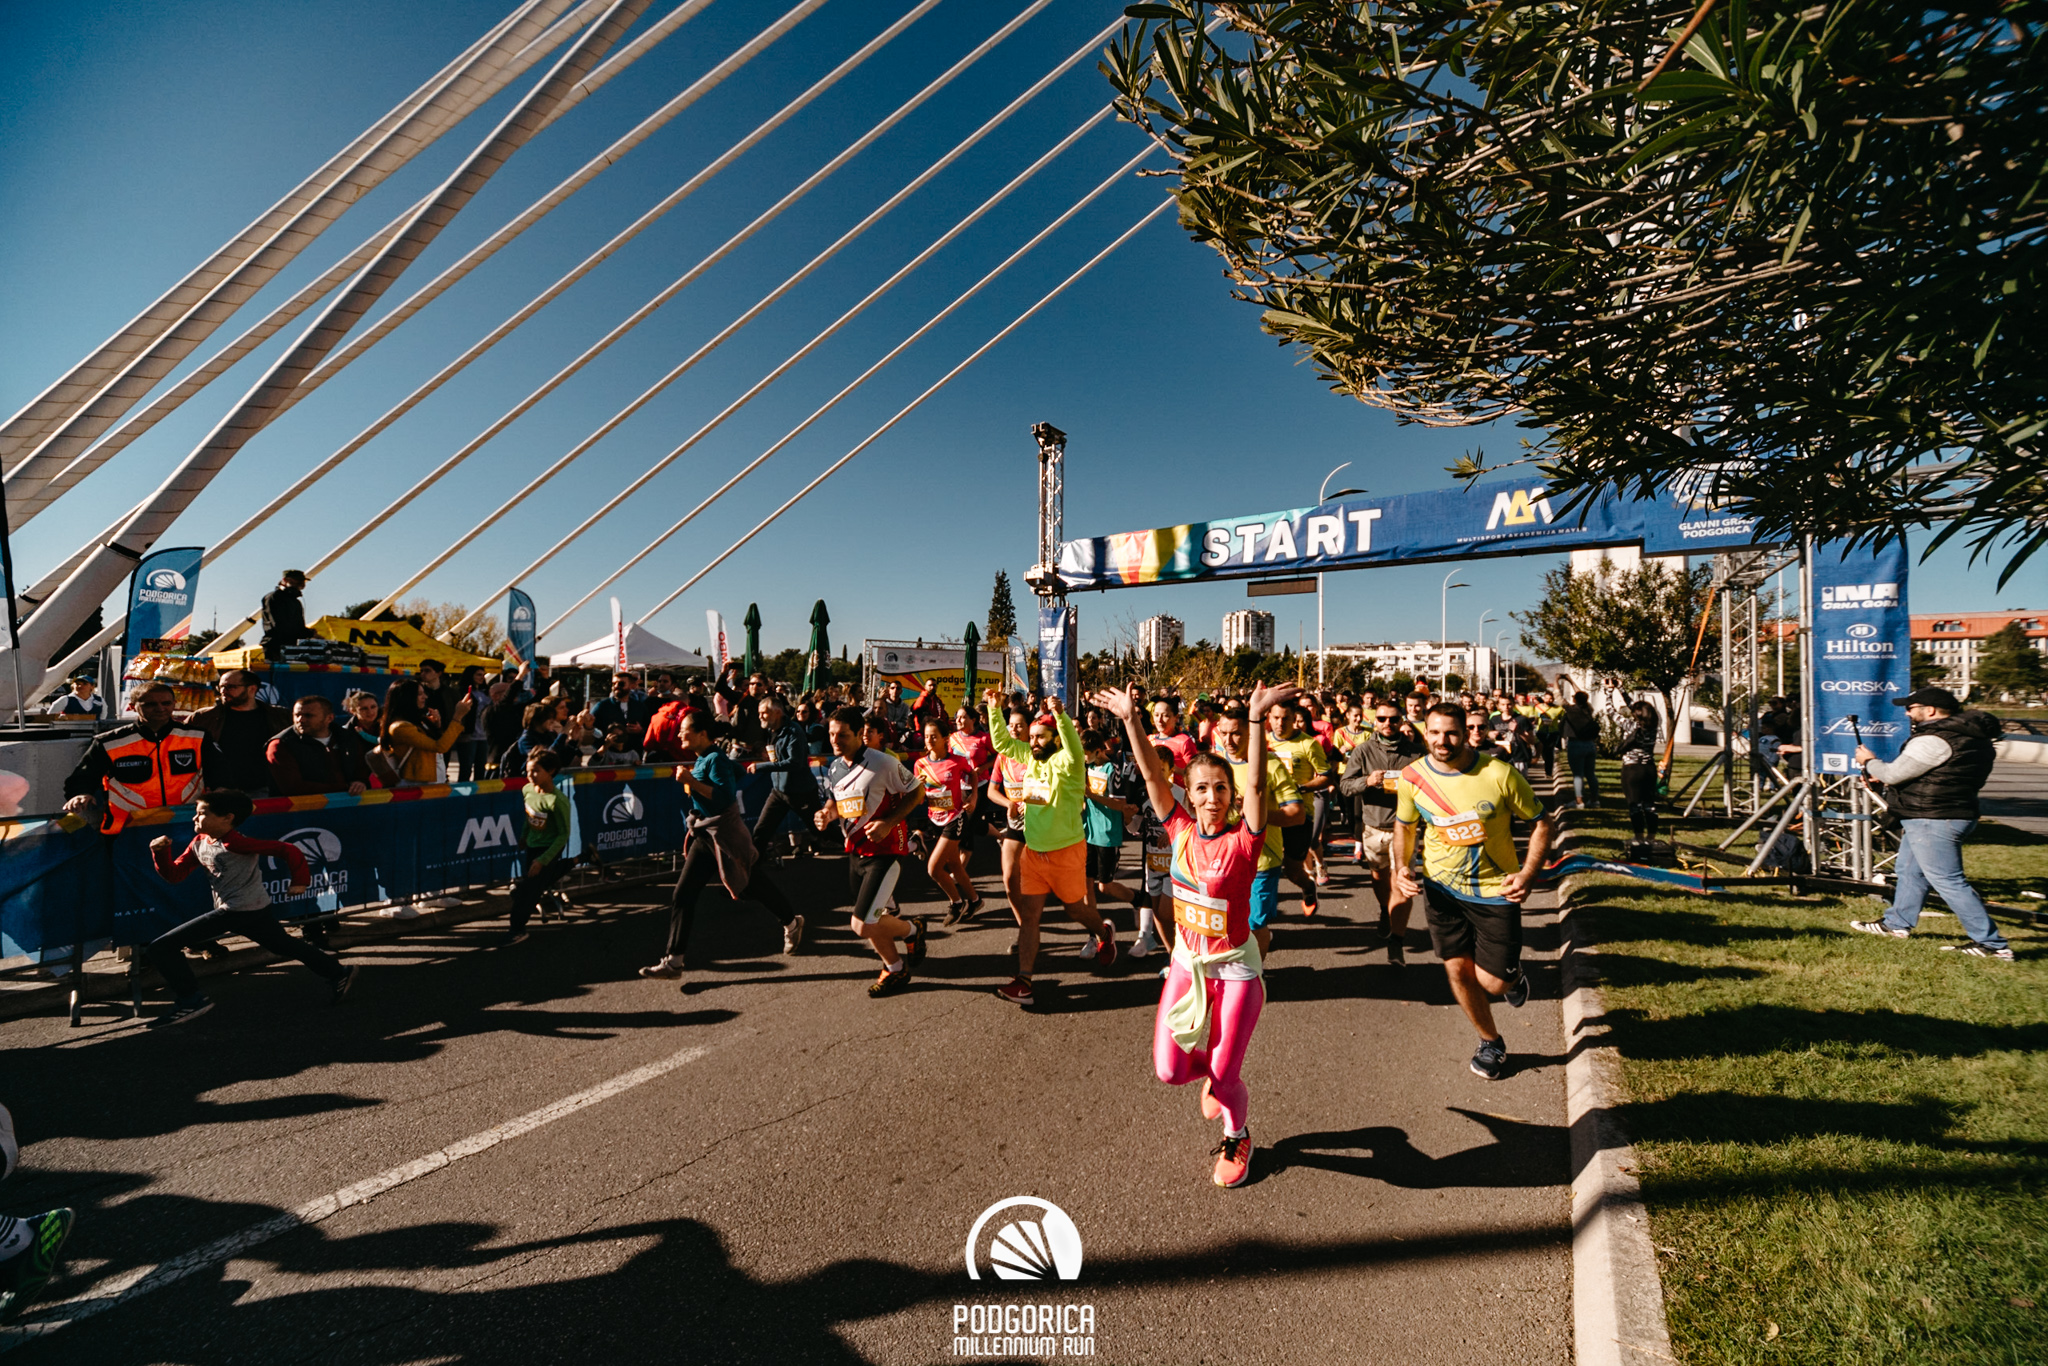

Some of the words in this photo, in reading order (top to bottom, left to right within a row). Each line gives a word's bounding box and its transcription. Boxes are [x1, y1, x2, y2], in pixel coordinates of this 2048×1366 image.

[1678, 519, 1720, 531] GLAVNI
[1683, 525, 1751, 539] PODGORICA
[1201, 508, 1382, 567] START
[1456, 533, 1506, 543] MULTISPORT
[1508, 529, 1556, 538] AKADEMIJA
[139, 589, 188, 601] PODGORICA
[1821, 601, 1860, 610] CRNA
[1861, 600, 1898, 609] GORA
[1826, 640, 1894, 653] Hilton
[936, 675, 1000, 686] podgoa.run
[1821, 680, 1900, 692] GORSKA
[1091, 779, 1106, 791] 57
[842, 799, 864, 813] 1247
[597, 827, 648, 844] PODGORICA
[1446, 823, 1484, 841] 622
[262, 869, 348, 894] PODRICA
[269, 886, 325, 904] ILLENNIUM
[328, 884, 348, 896] RUN
[114, 907, 156, 917] MAYER
[1185, 905, 1224, 931] 618
